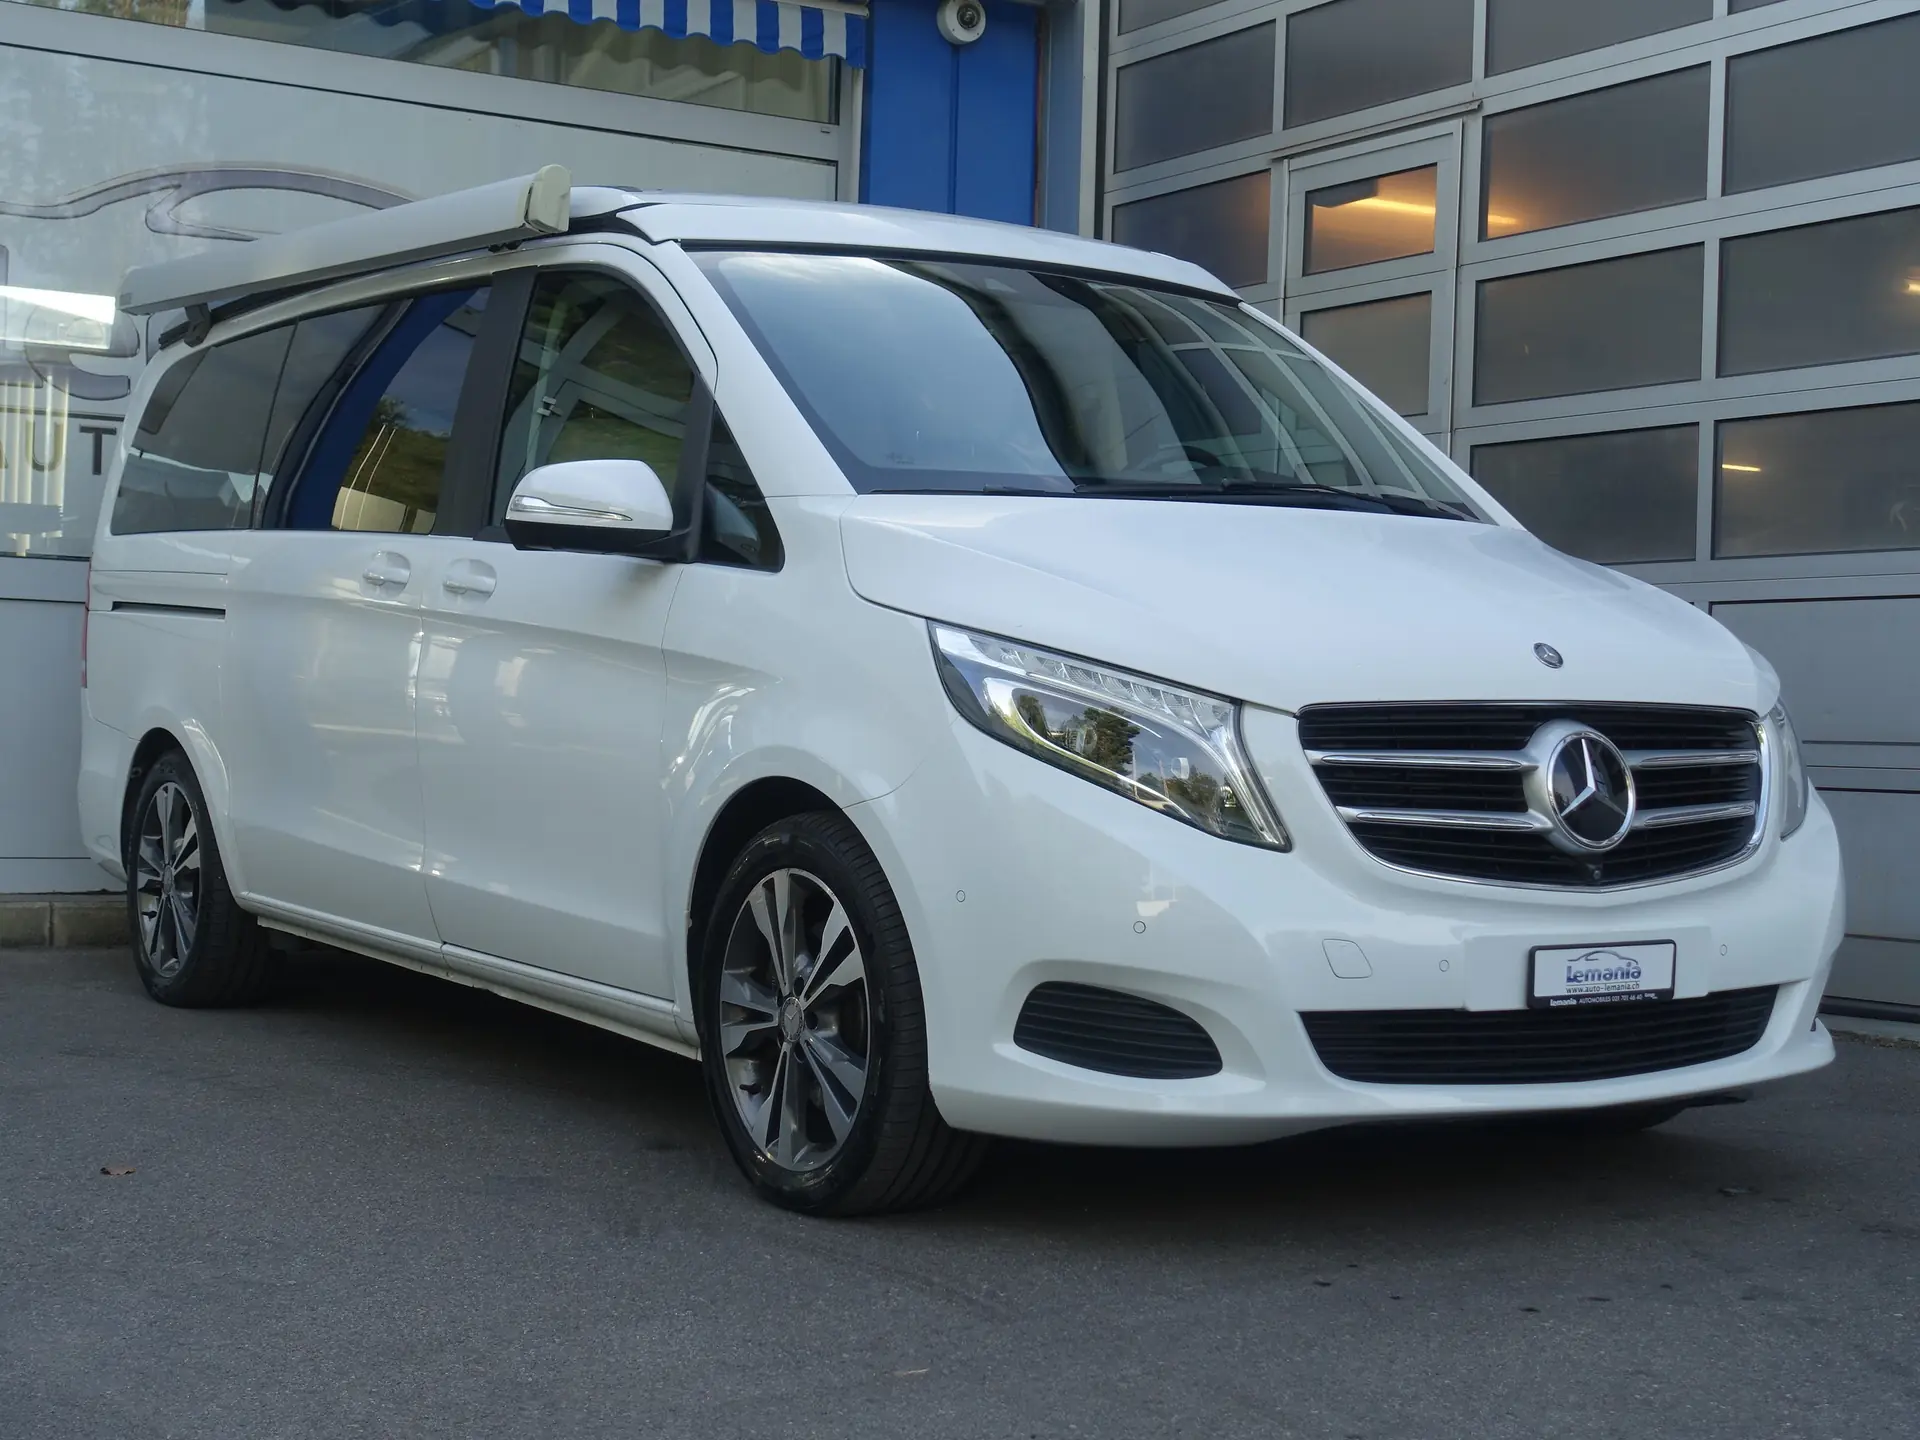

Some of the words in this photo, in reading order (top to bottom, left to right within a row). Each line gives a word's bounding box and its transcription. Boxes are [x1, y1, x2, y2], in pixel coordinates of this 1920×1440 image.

[1566, 962, 1641, 983] Lemania
[1566, 982, 1640, 993] www.auto-lemania.ch
[1579, 996, 1611, 1004] AUTOMOBILES
